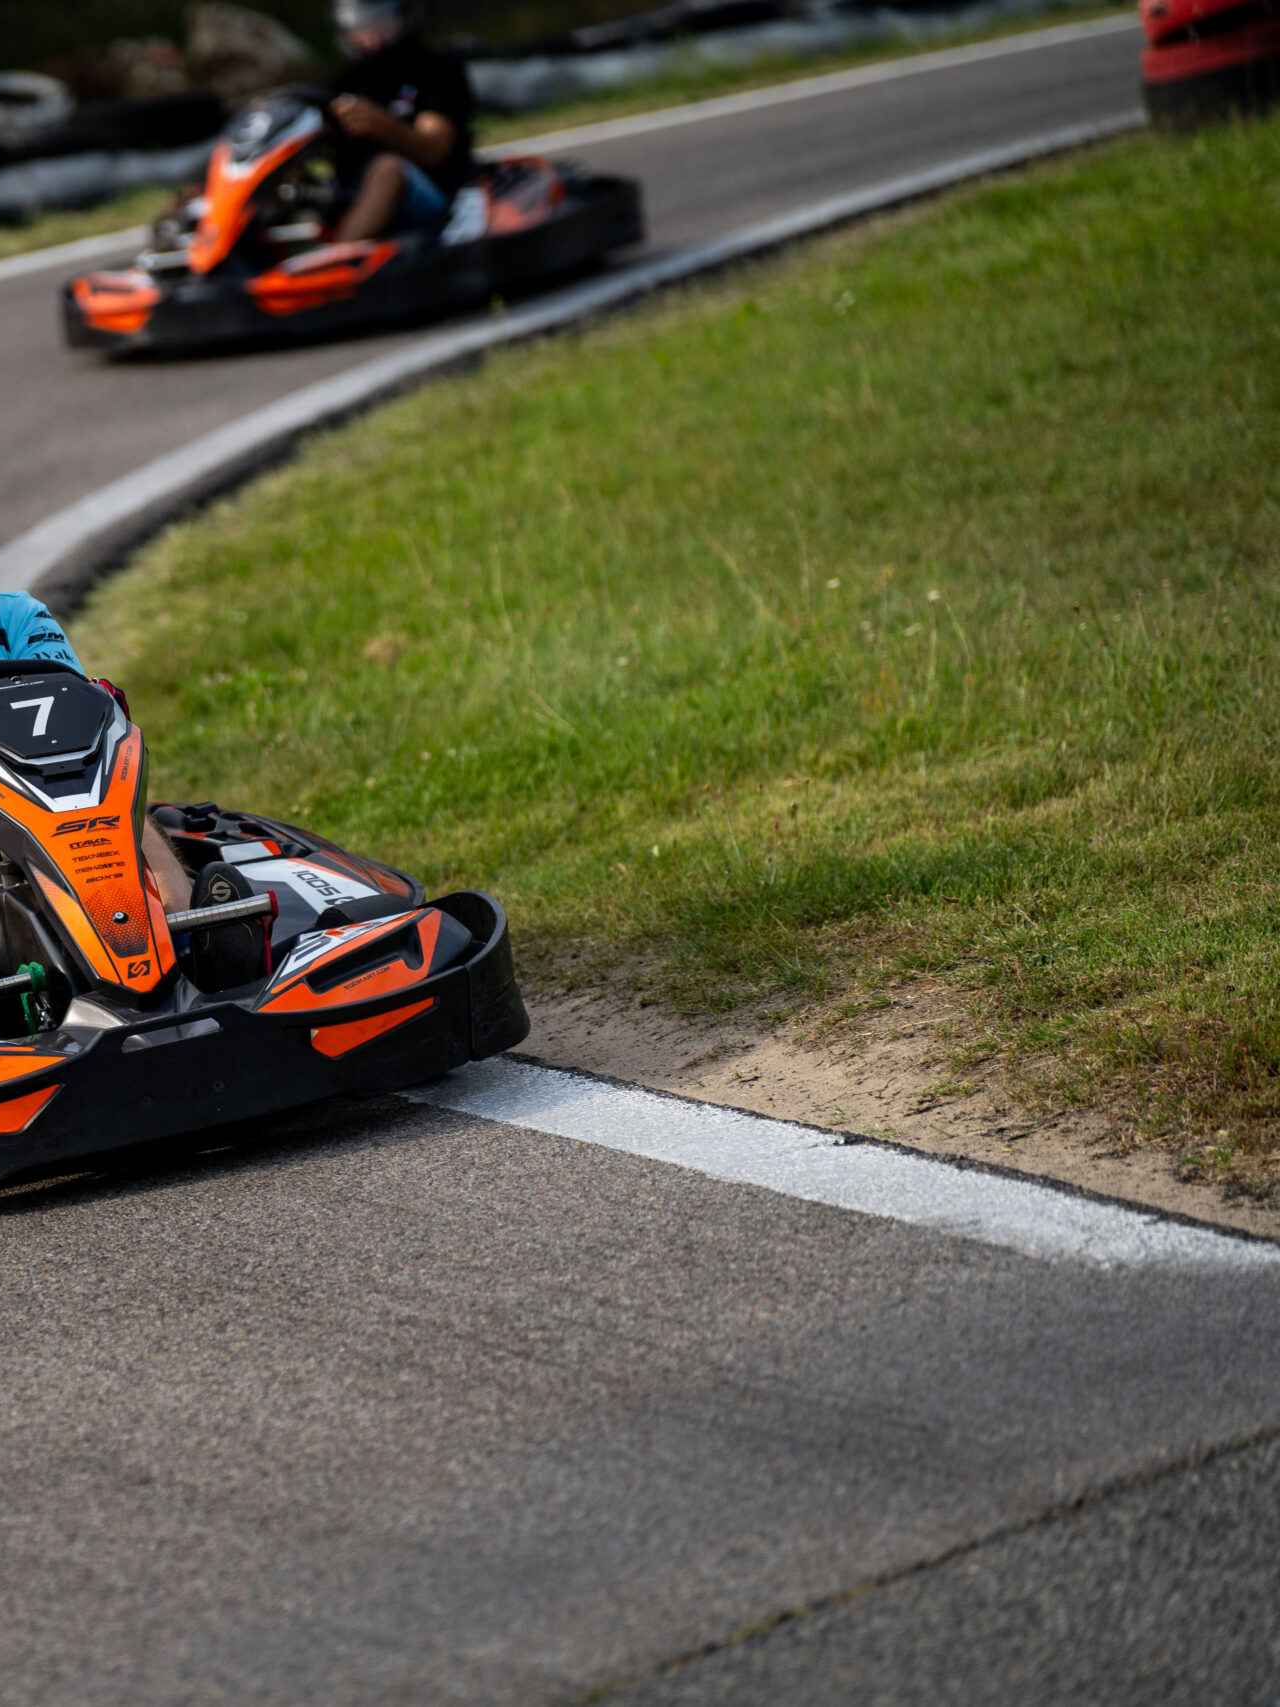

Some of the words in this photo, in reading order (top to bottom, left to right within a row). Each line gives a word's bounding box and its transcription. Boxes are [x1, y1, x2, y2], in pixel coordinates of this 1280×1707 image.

[10, 696, 55, 737] 7
[50, 815, 120, 838] SR
[69, 837, 112, 850] ITAKA
